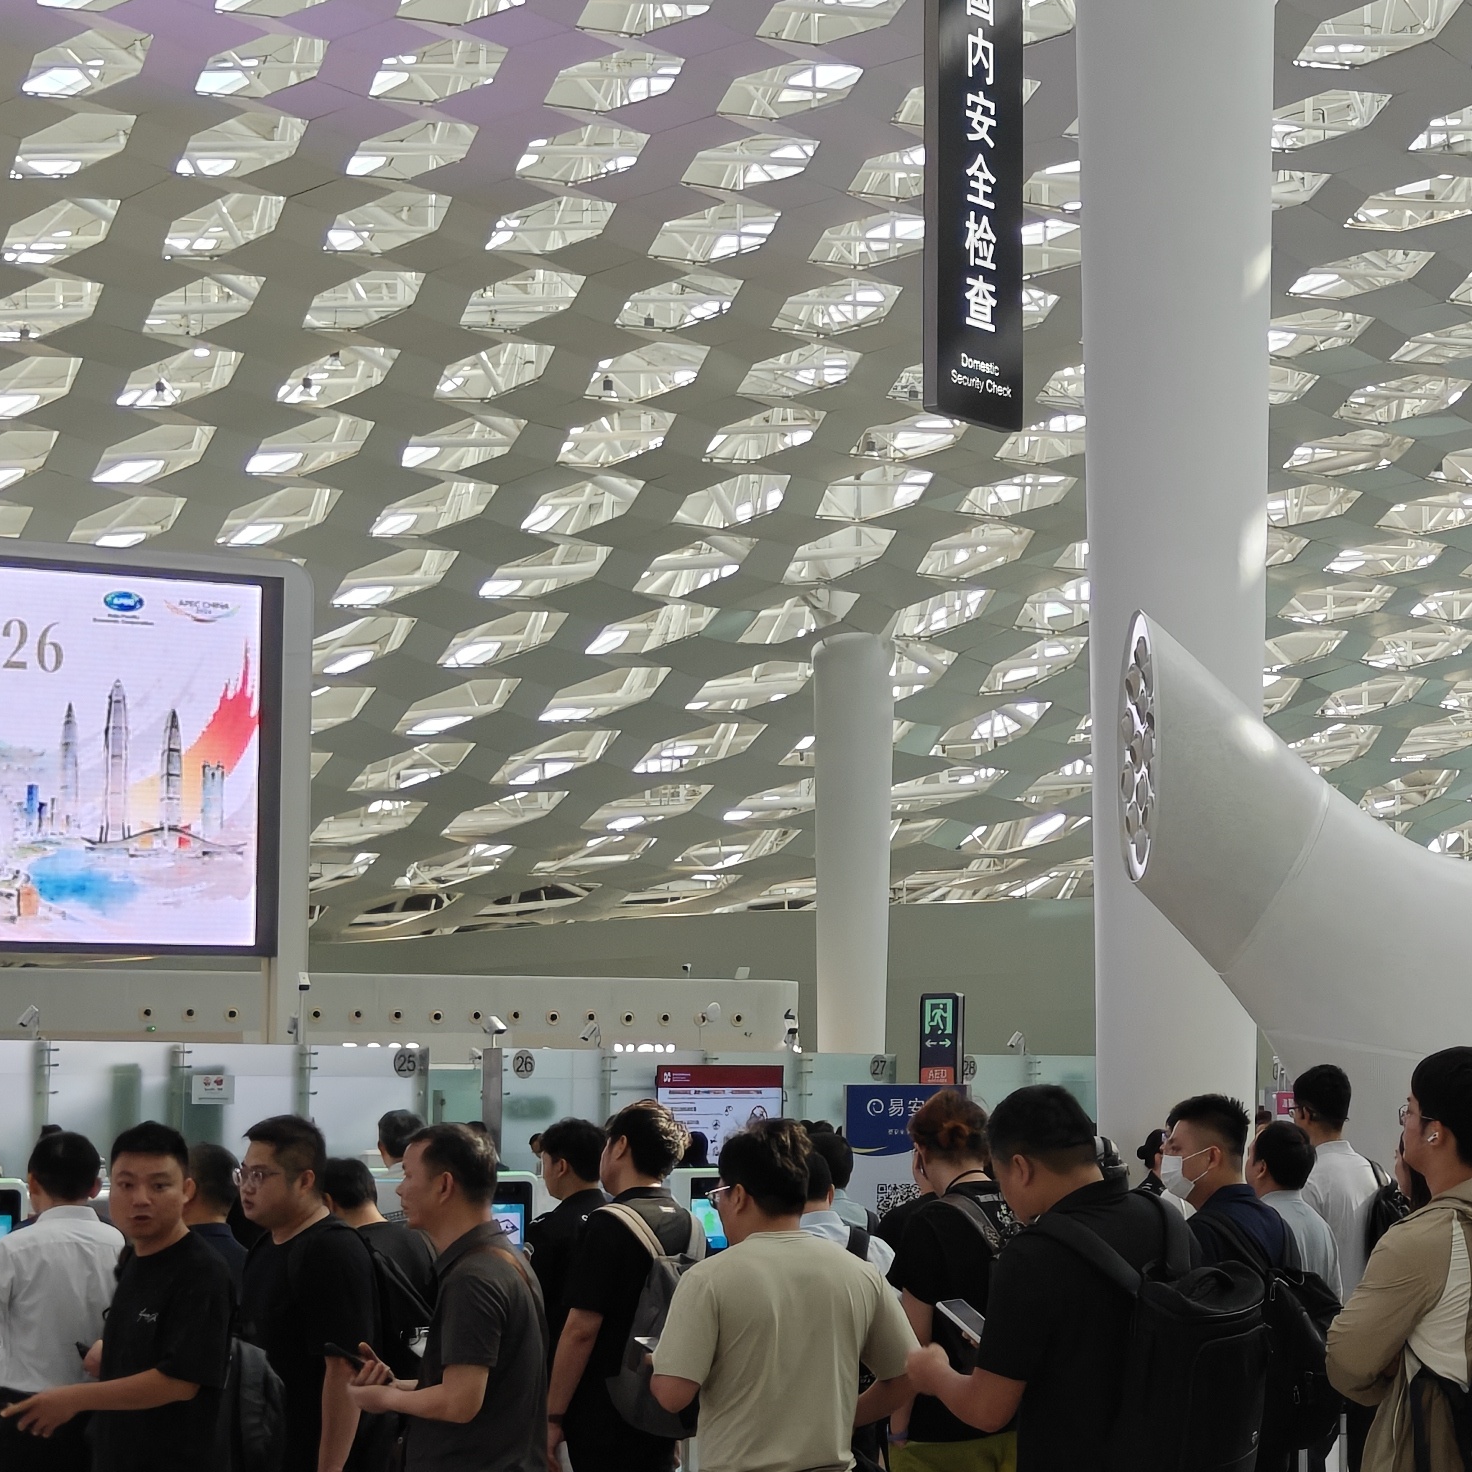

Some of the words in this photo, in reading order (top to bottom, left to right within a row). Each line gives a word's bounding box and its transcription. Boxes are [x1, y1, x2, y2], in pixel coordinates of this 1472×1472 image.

[961, 352, 1000, 377] Domestic
[950, 369, 984, 393] Security
[985, 379, 1012, 398] Check
[395, 1052, 418, 1073] 25
[513, 1053, 534, 1073] 26
[873, 1060, 887, 1075] 27
[964, 1061, 976, 1075] 28
[928, 1069, 947, 1079] AED
